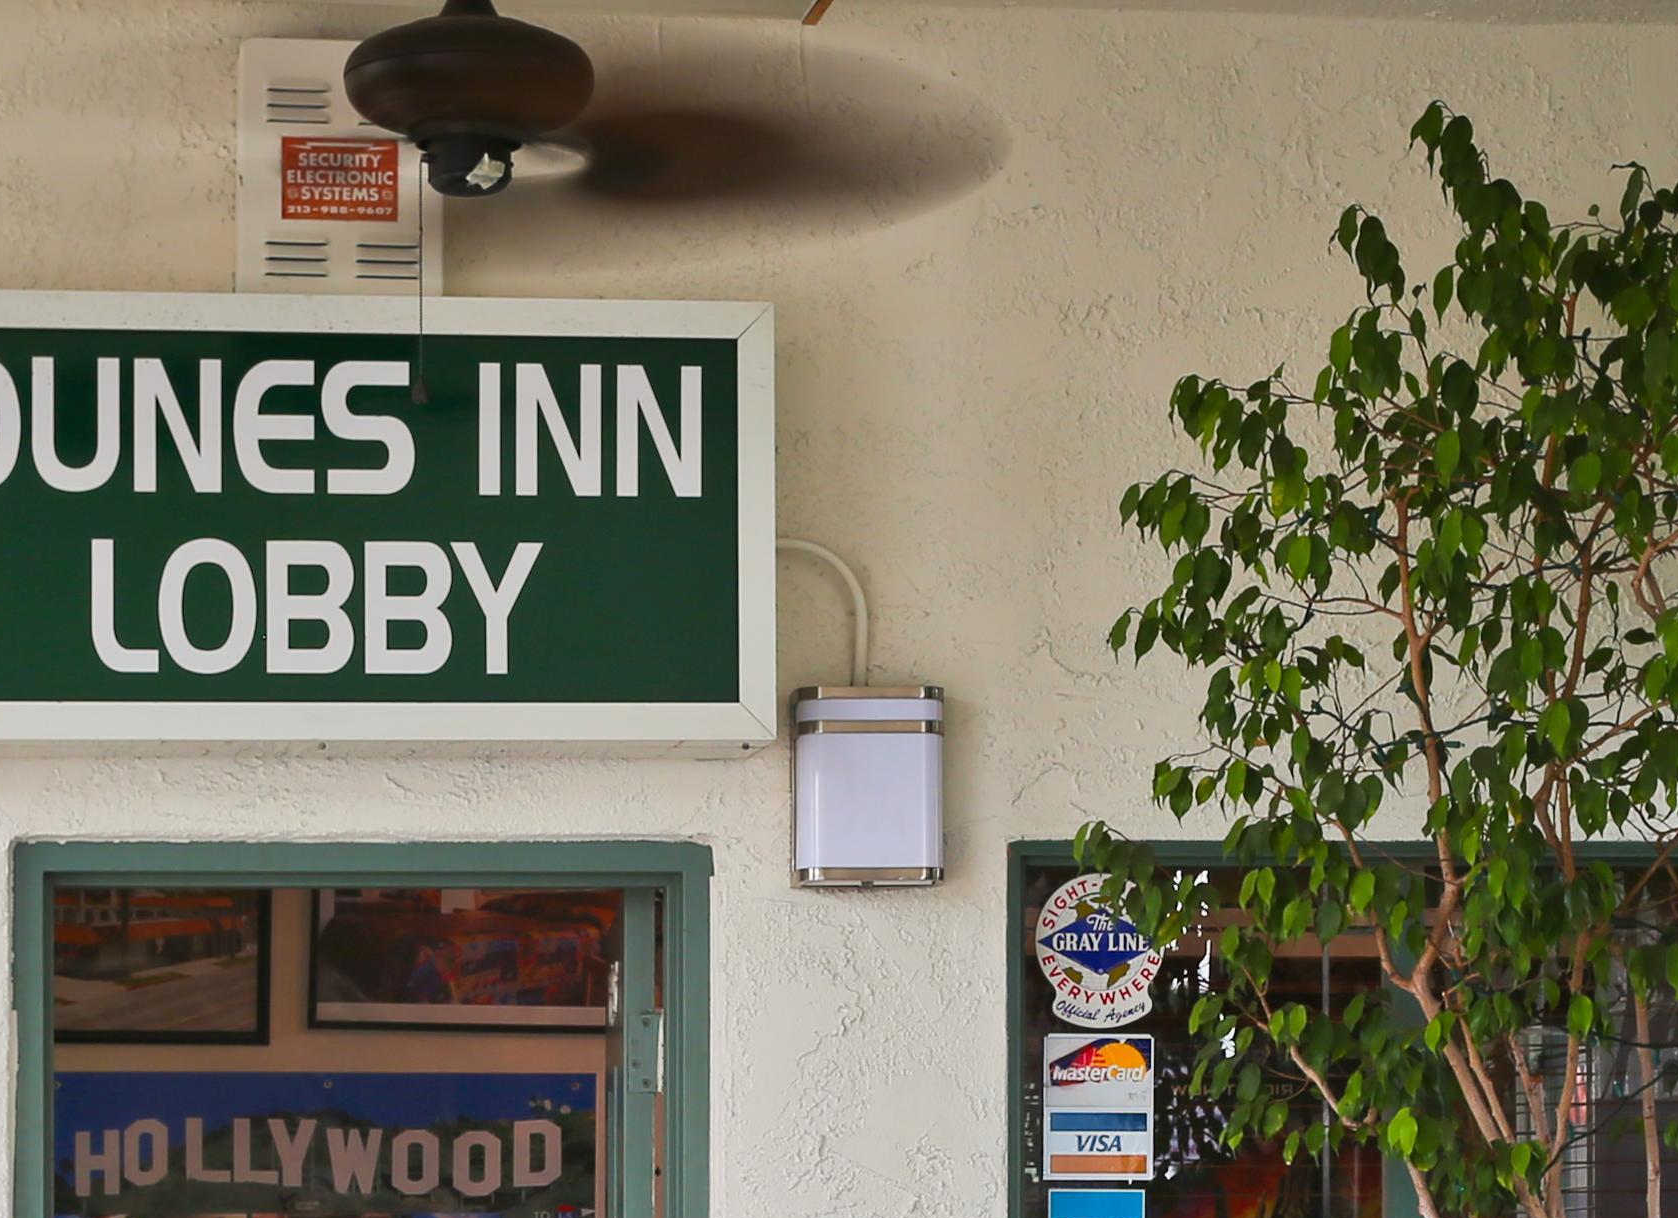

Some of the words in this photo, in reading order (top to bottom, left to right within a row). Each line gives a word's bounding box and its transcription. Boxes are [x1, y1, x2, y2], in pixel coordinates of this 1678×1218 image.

[298, 153, 381, 168] SECURITY
[287, 170, 394, 185] ELECTRONIC
[301, 187, 379, 201] SYSTEMS
[478, 363, 703, 497] INN
[90, 538, 543, 675] LOBBY
[1052, 933, 1105, 951] GRAY
[1107, 933, 1150, 952] LINE
[1042, 954, 1160, 1006] EVERYWHERE
[1056, 1000, 1101, 1020] Official
[1104, 1001, 1145, 1023] Agency
[1052, 1065, 1144, 1082] MasterCard
[1076, 1134, 1122, 1152] VISA
[75, 1117, 561, 1198] HOLLYWOOD
